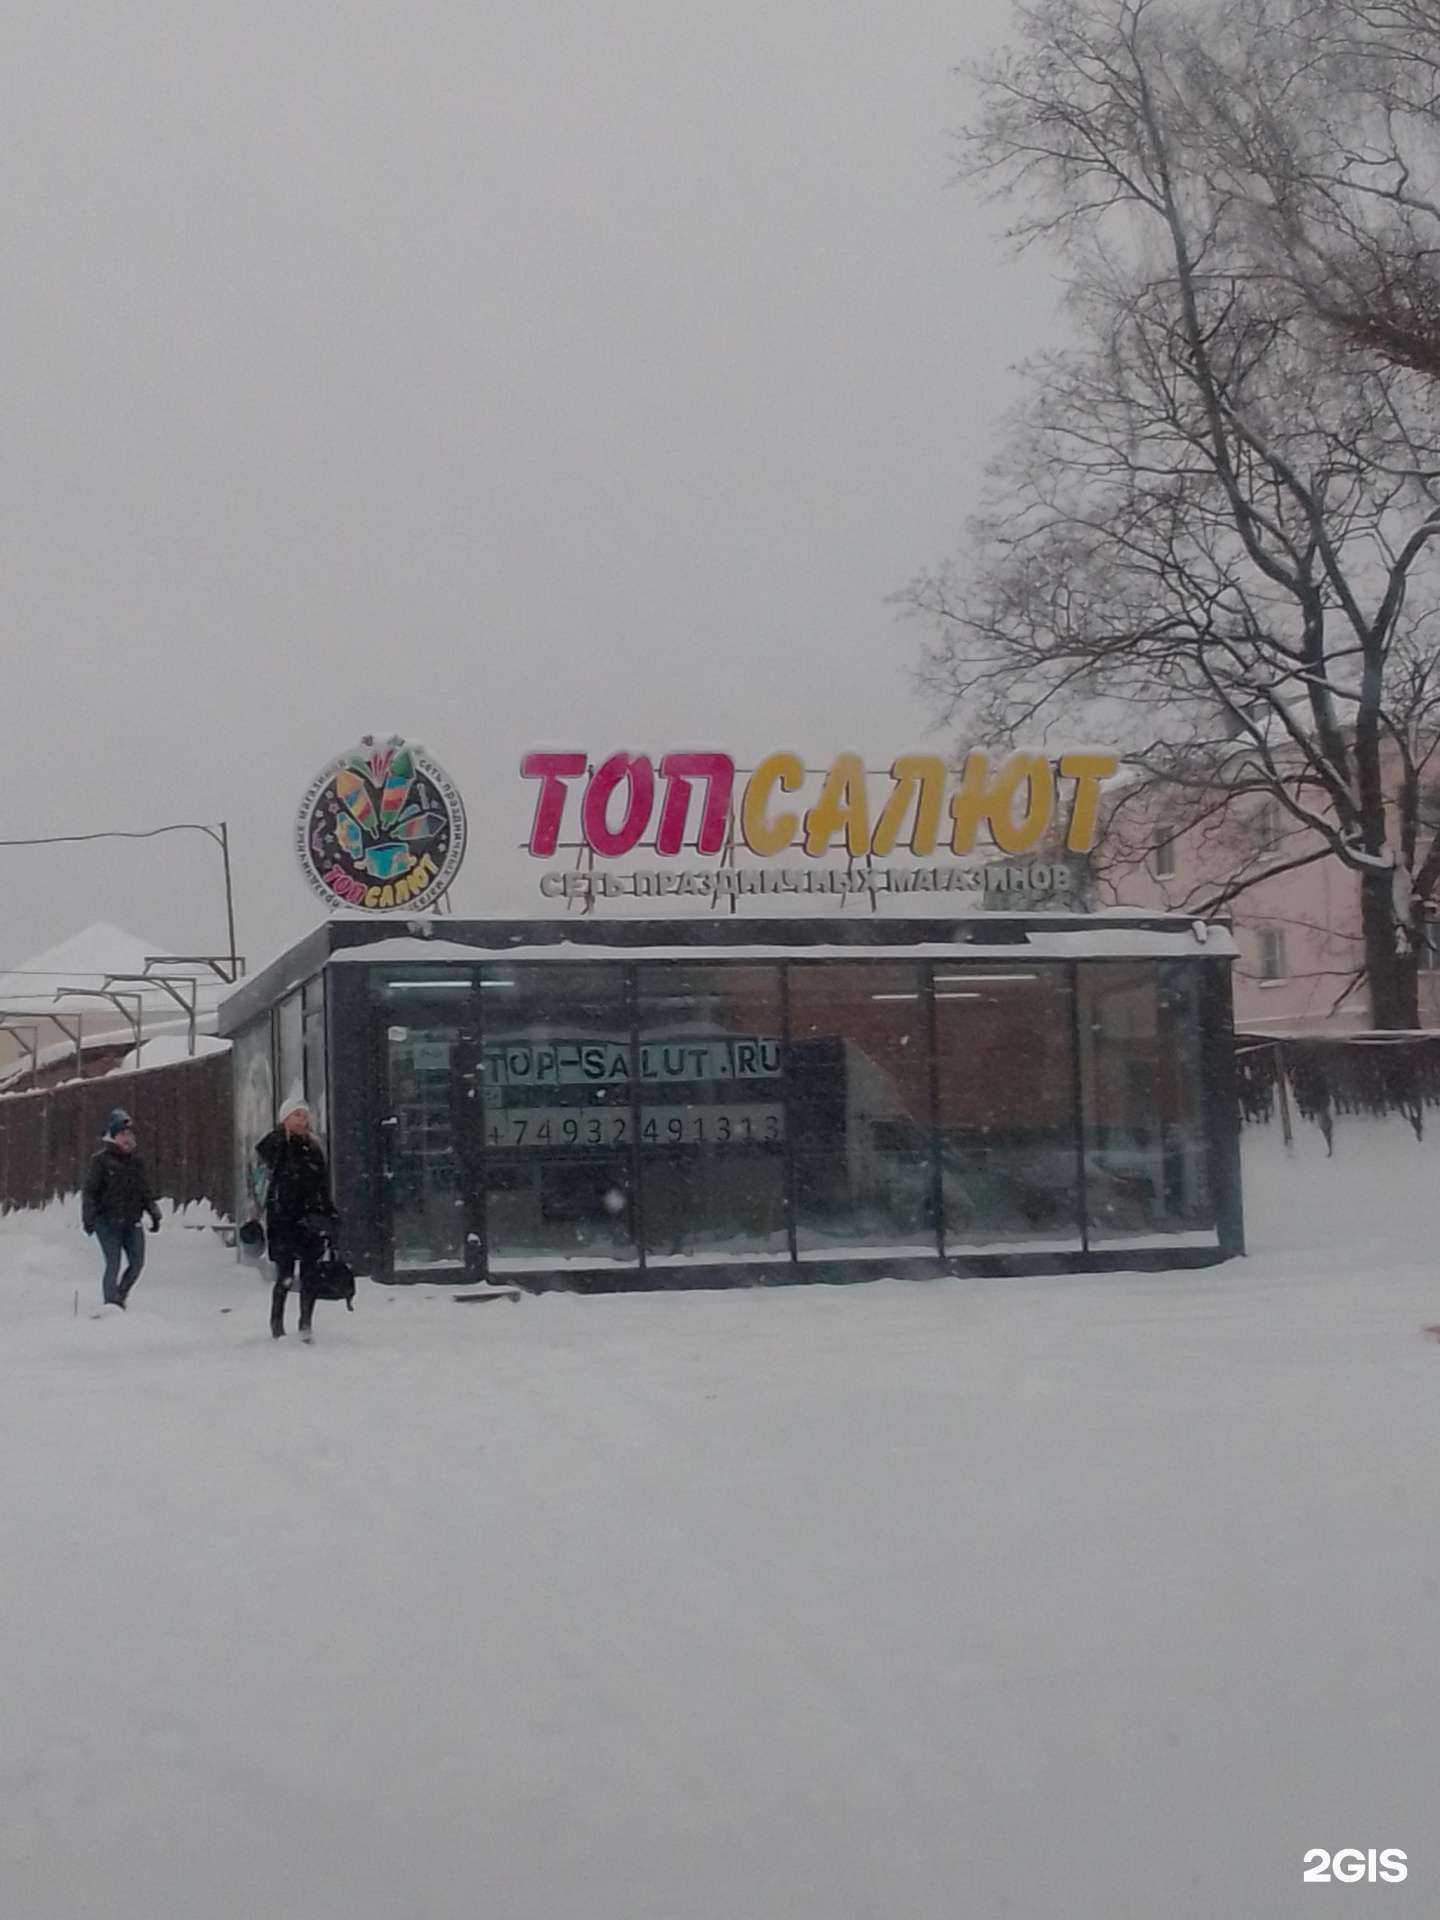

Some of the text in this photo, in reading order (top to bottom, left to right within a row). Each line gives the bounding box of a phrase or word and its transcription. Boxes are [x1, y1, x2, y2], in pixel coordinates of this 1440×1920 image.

[541, 864, 1072, 897] СЕТЬ ПРАЗДНИЧНЫХ МАГАЗИНОВ
